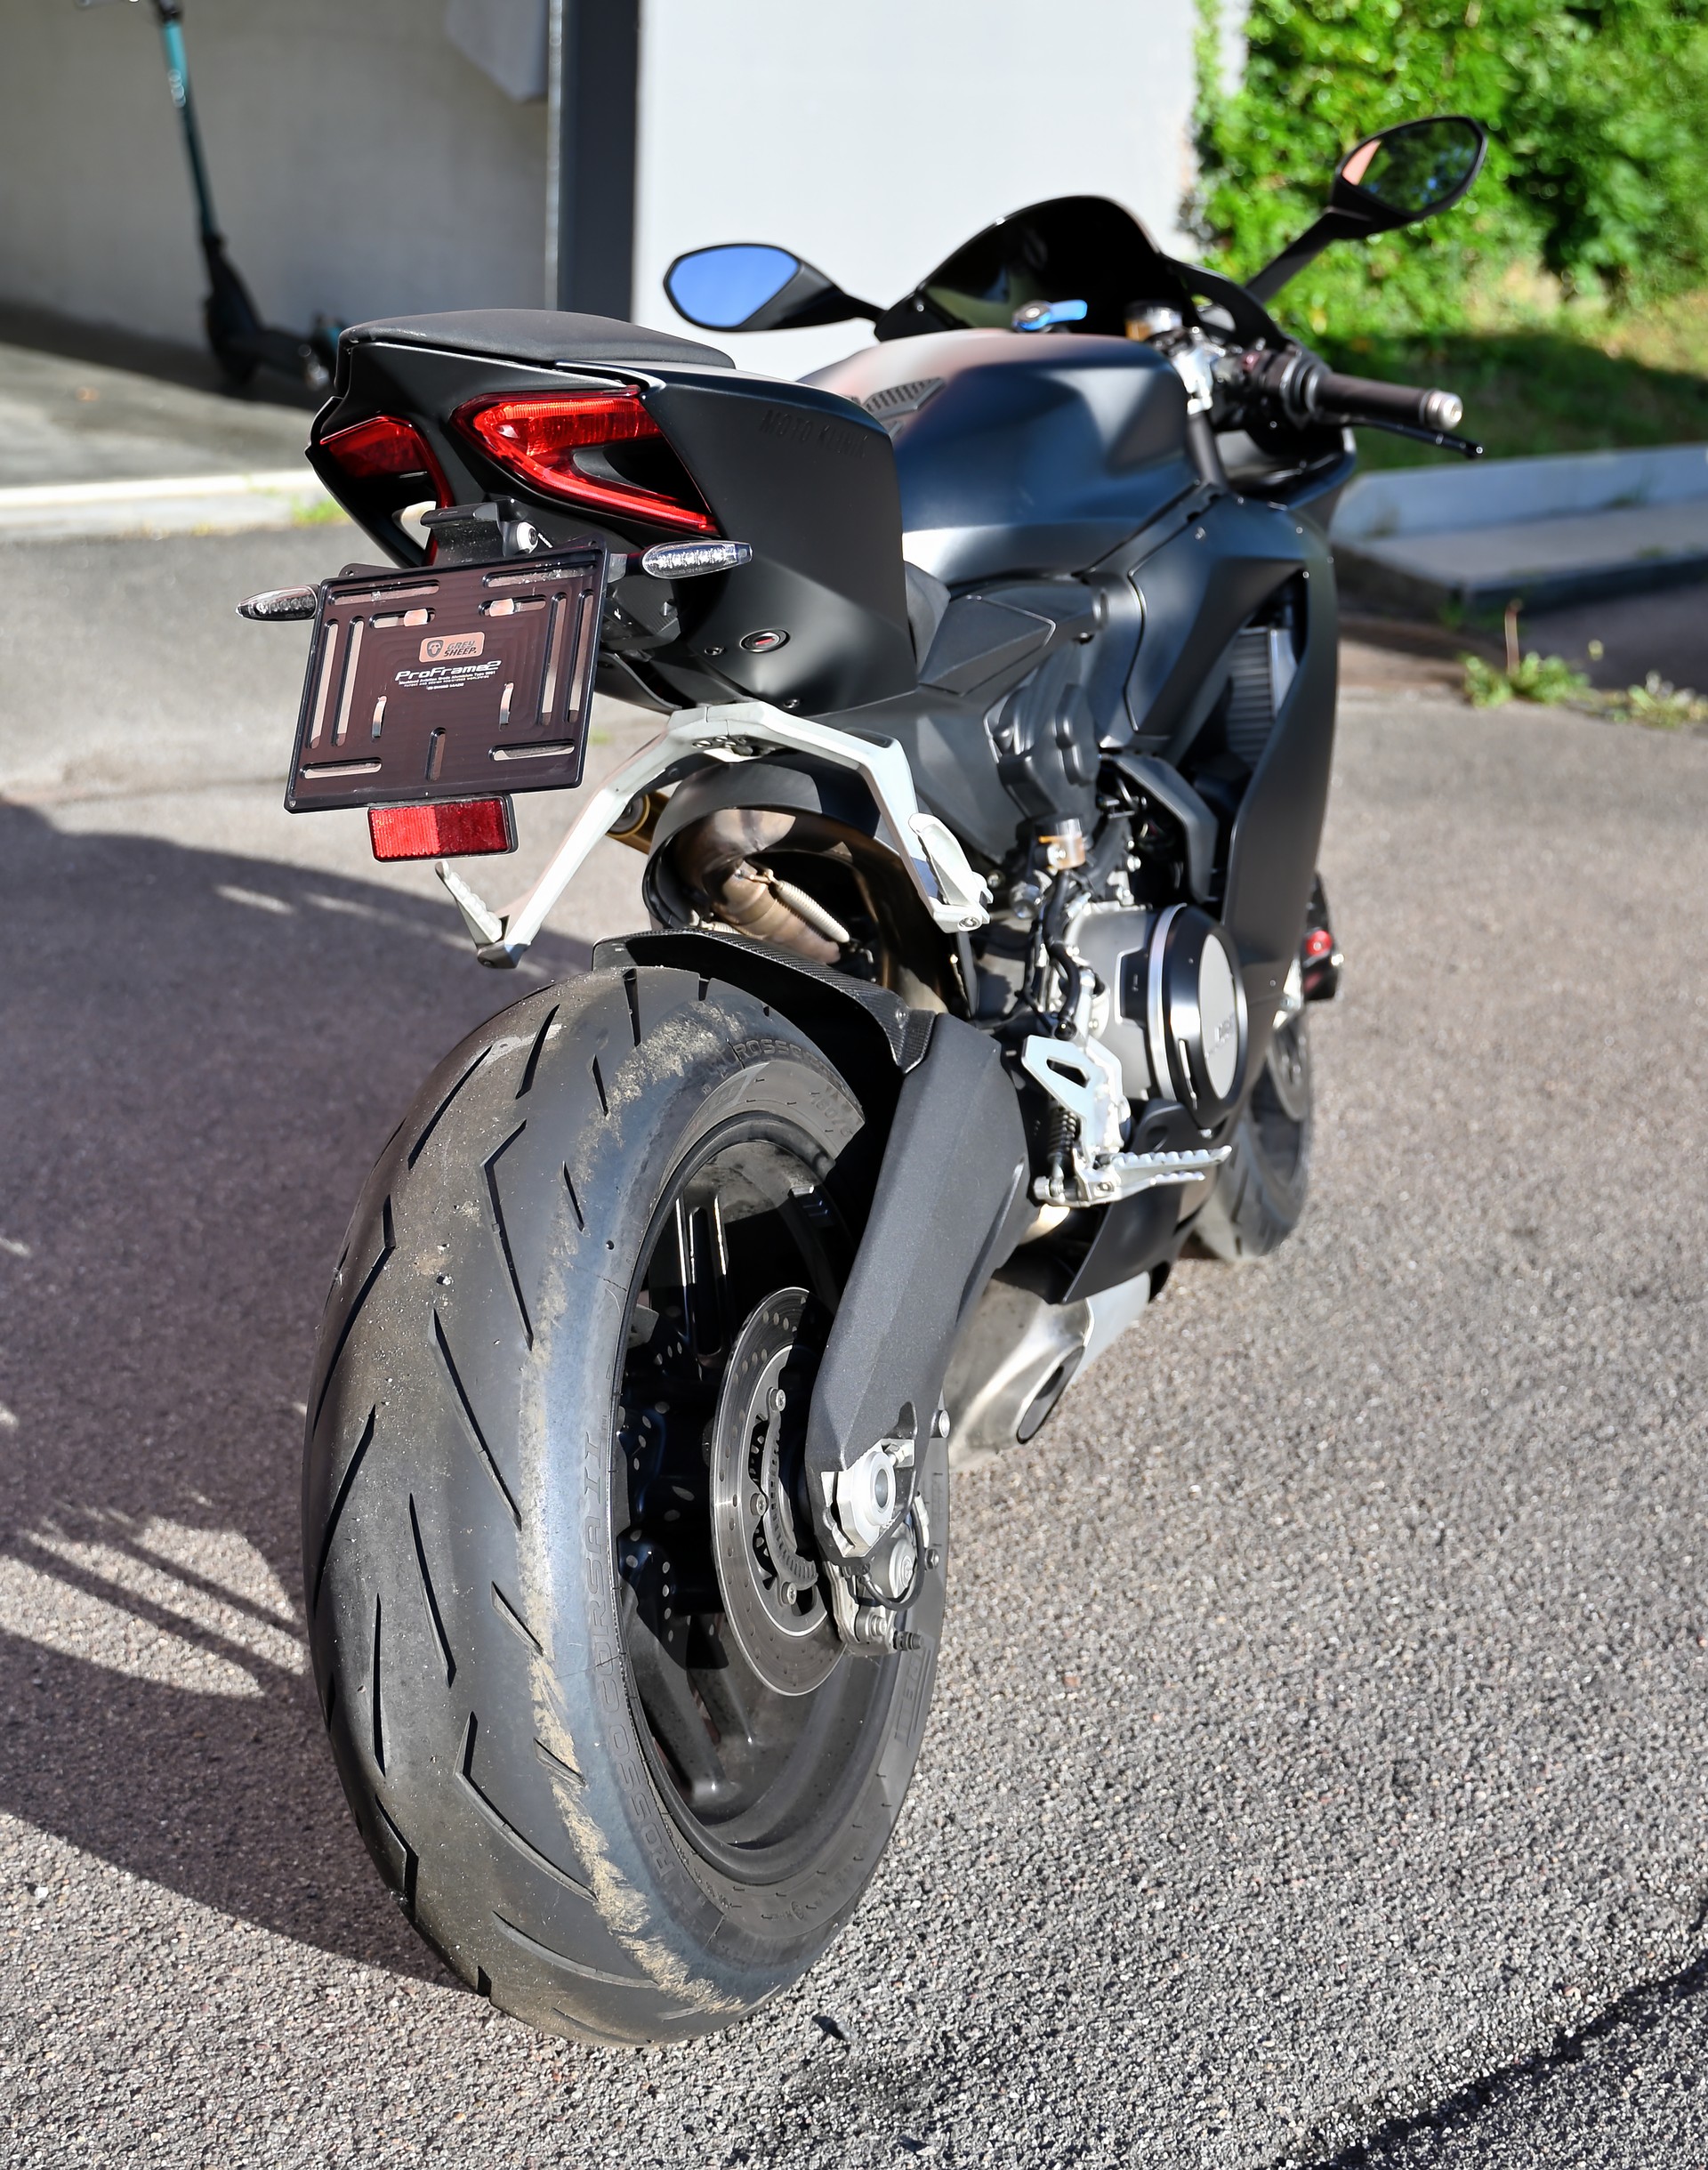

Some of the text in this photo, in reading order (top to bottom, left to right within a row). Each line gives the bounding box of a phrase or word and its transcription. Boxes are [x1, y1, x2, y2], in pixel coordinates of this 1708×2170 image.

[758, 408, 814, 444] MOTO
[447, 641, 475, 651] GREY
[394, 660, 503, 681] ProFrame2
[584, 1518, 621, 1715] CORSA
[607, 1722, 676, 1879] ROSSO
